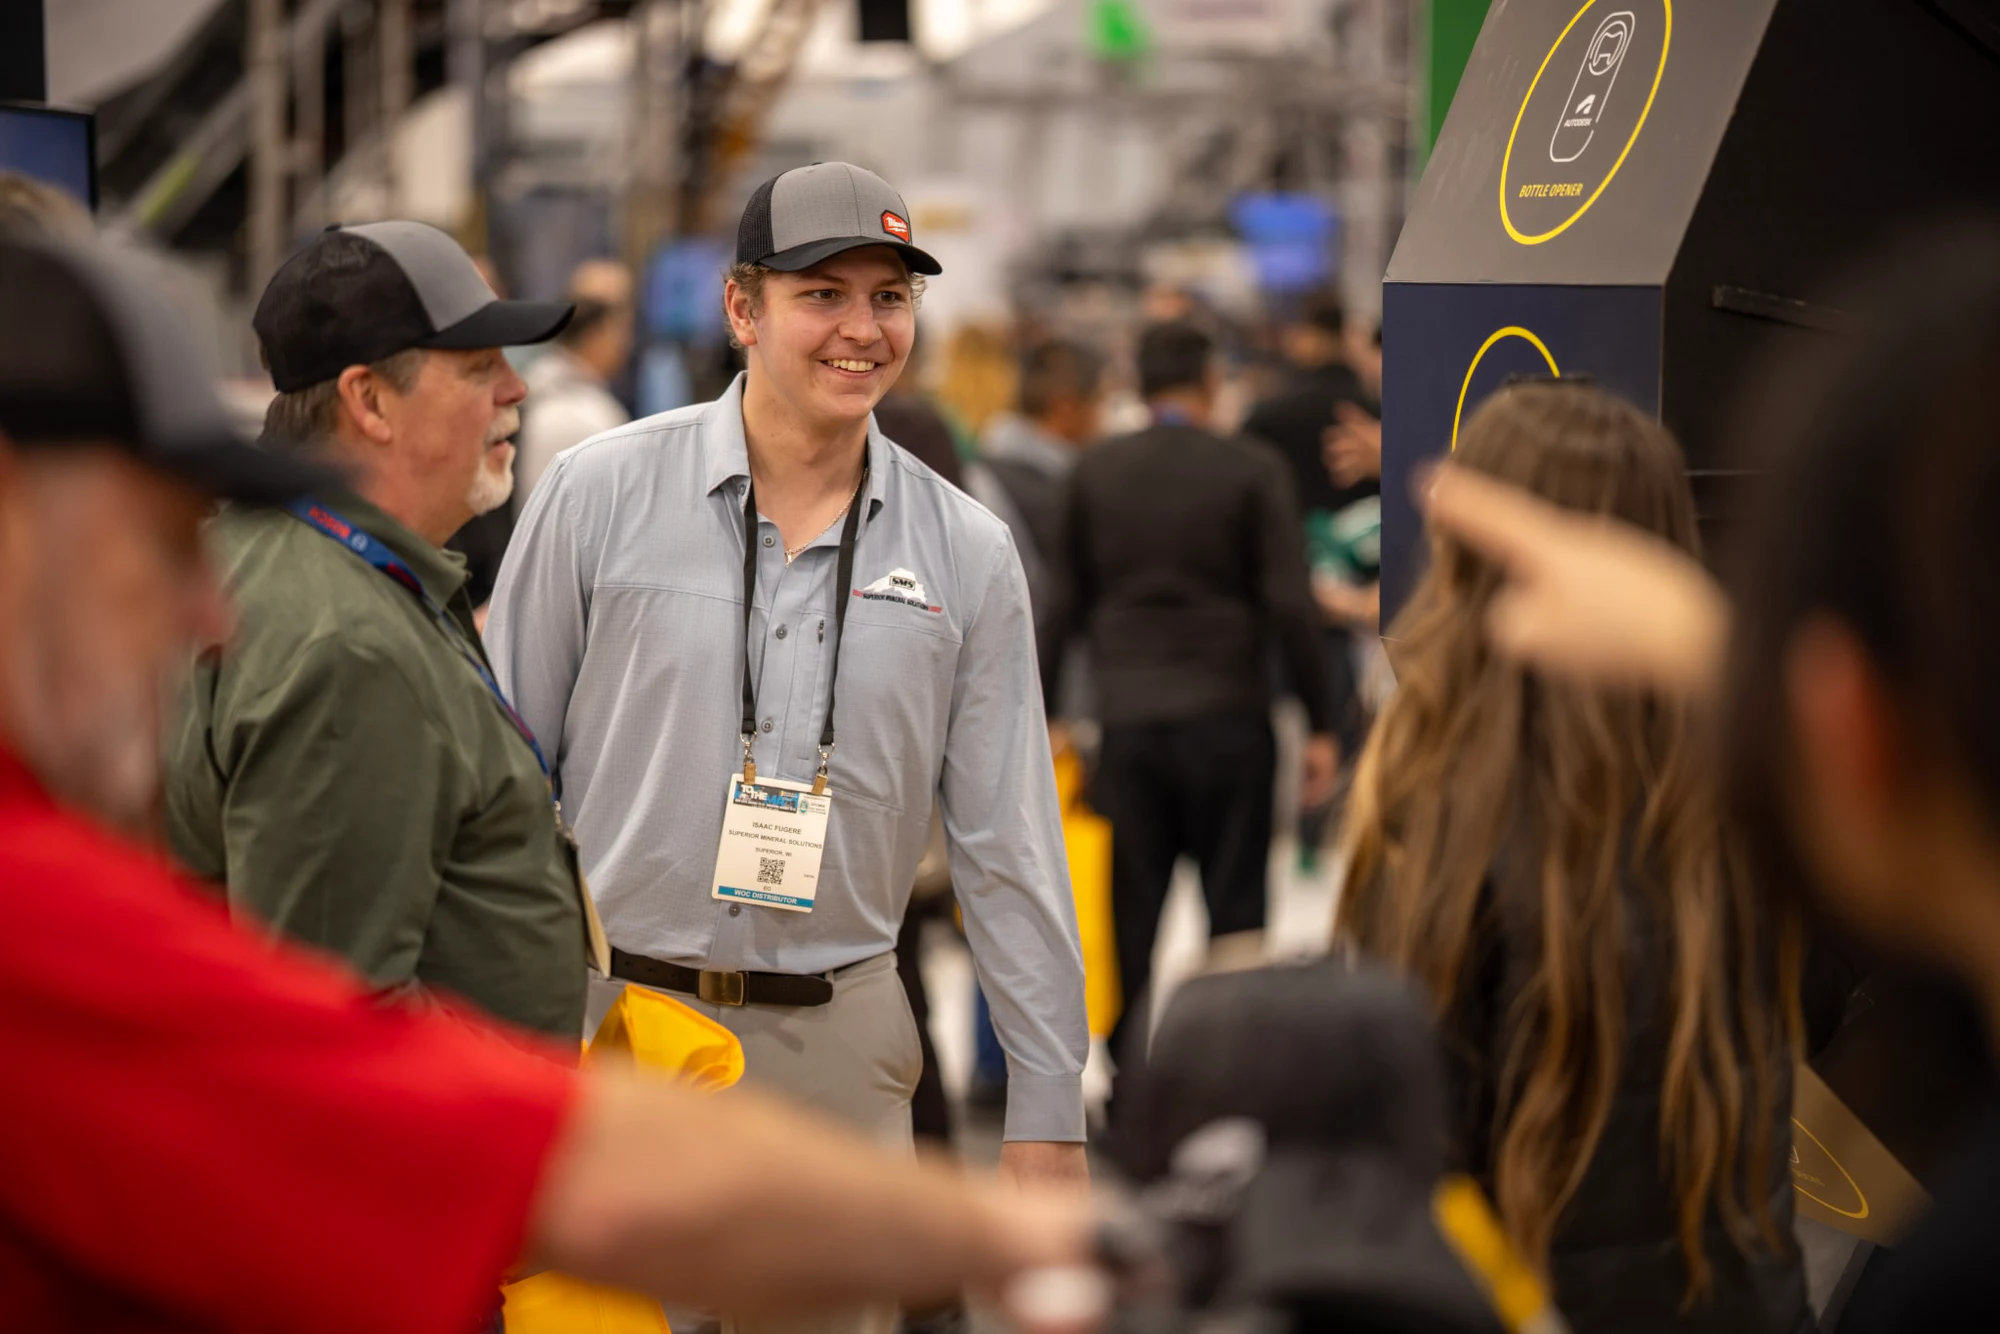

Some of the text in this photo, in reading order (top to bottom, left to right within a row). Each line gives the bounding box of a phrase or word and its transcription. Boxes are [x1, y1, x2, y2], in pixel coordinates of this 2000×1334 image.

[1564, 118, 1592, 127] AUTODESK
[1519, 182, 1584, 197] BOTTLE OPENER
[892, 577, 914, 589] SMS
[862, 593, 886, 601] SUPERIOR
[886, 594, 906, 604] MINERAL
[741, 784, 754, 795] TO
[751, 790, 769, 800] THE
[752, 821, 802, 835] ISAAC FUGERE
[728, 829, 823, 849] SUPERIOR MINERAL SOLUTIONS
[734, 889, 798, 905] WOC DISTRIBUTOR
